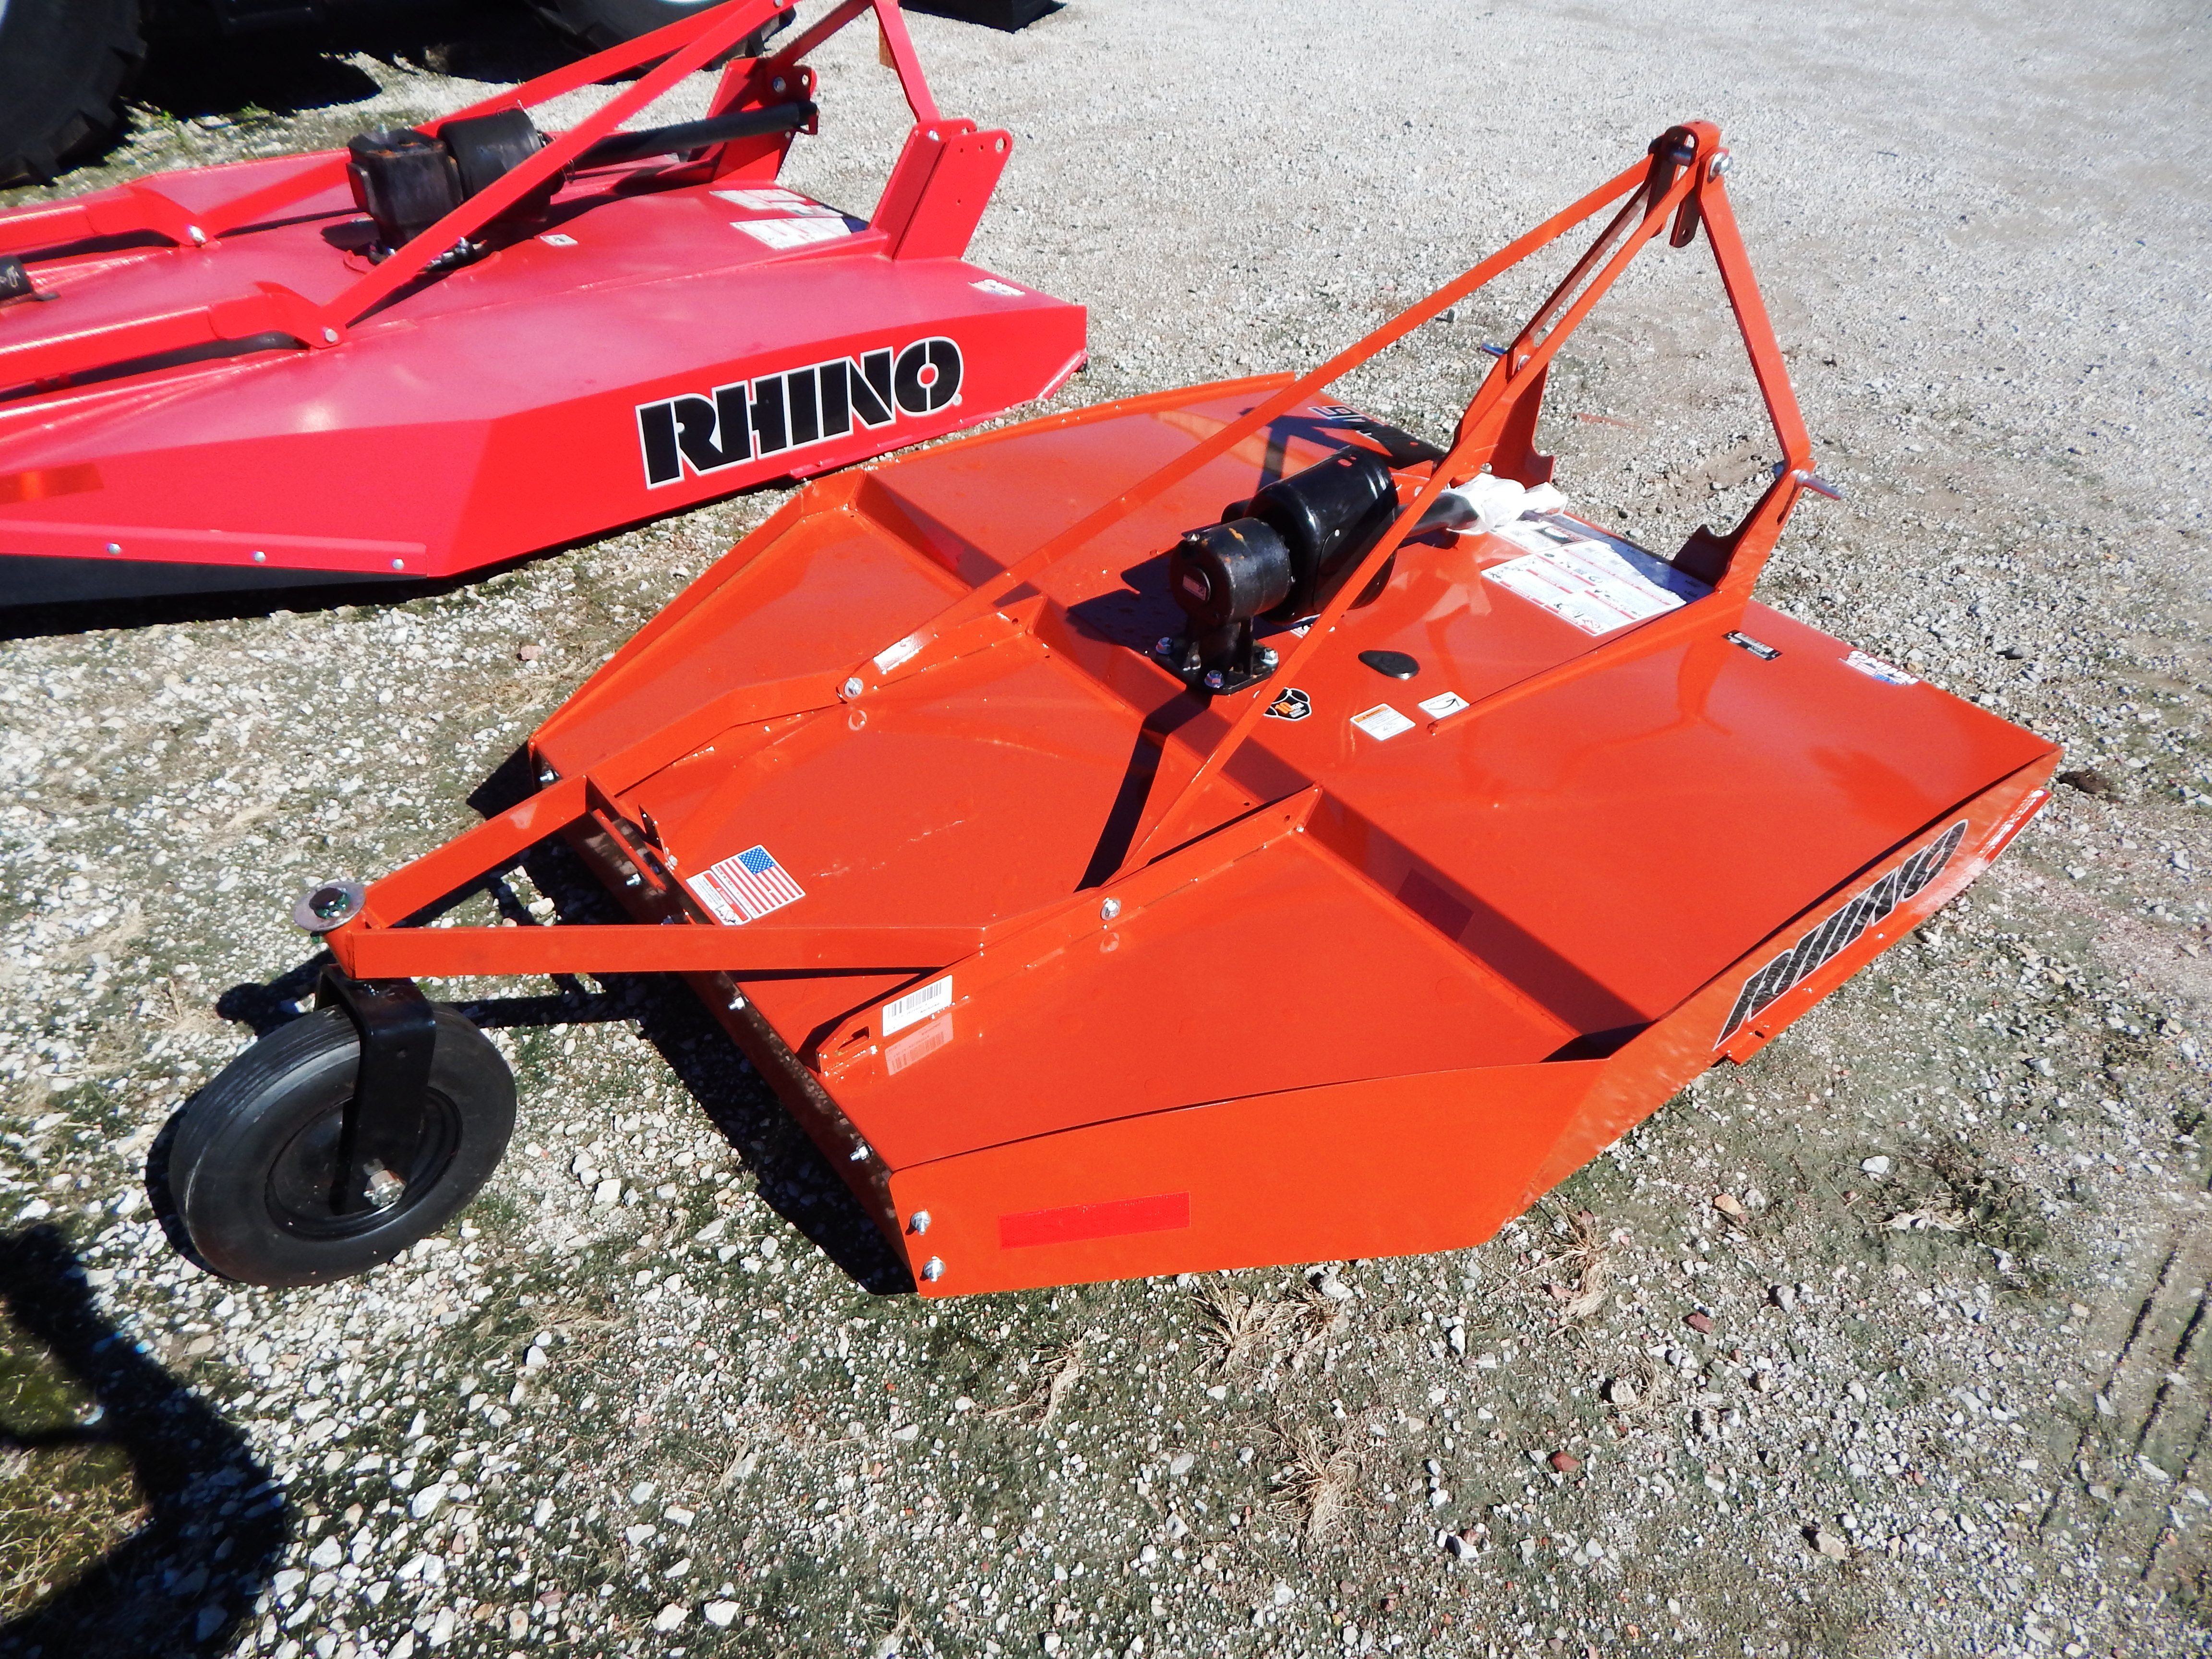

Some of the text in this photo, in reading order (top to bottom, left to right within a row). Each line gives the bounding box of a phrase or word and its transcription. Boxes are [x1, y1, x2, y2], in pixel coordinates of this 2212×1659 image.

[635, 336, 963, 489] RHINO
[1275, 702, 1293, 714] 10
[721, 890, 733, 905] DANGER
[1713, 818, 1969, 1051] RHINO
